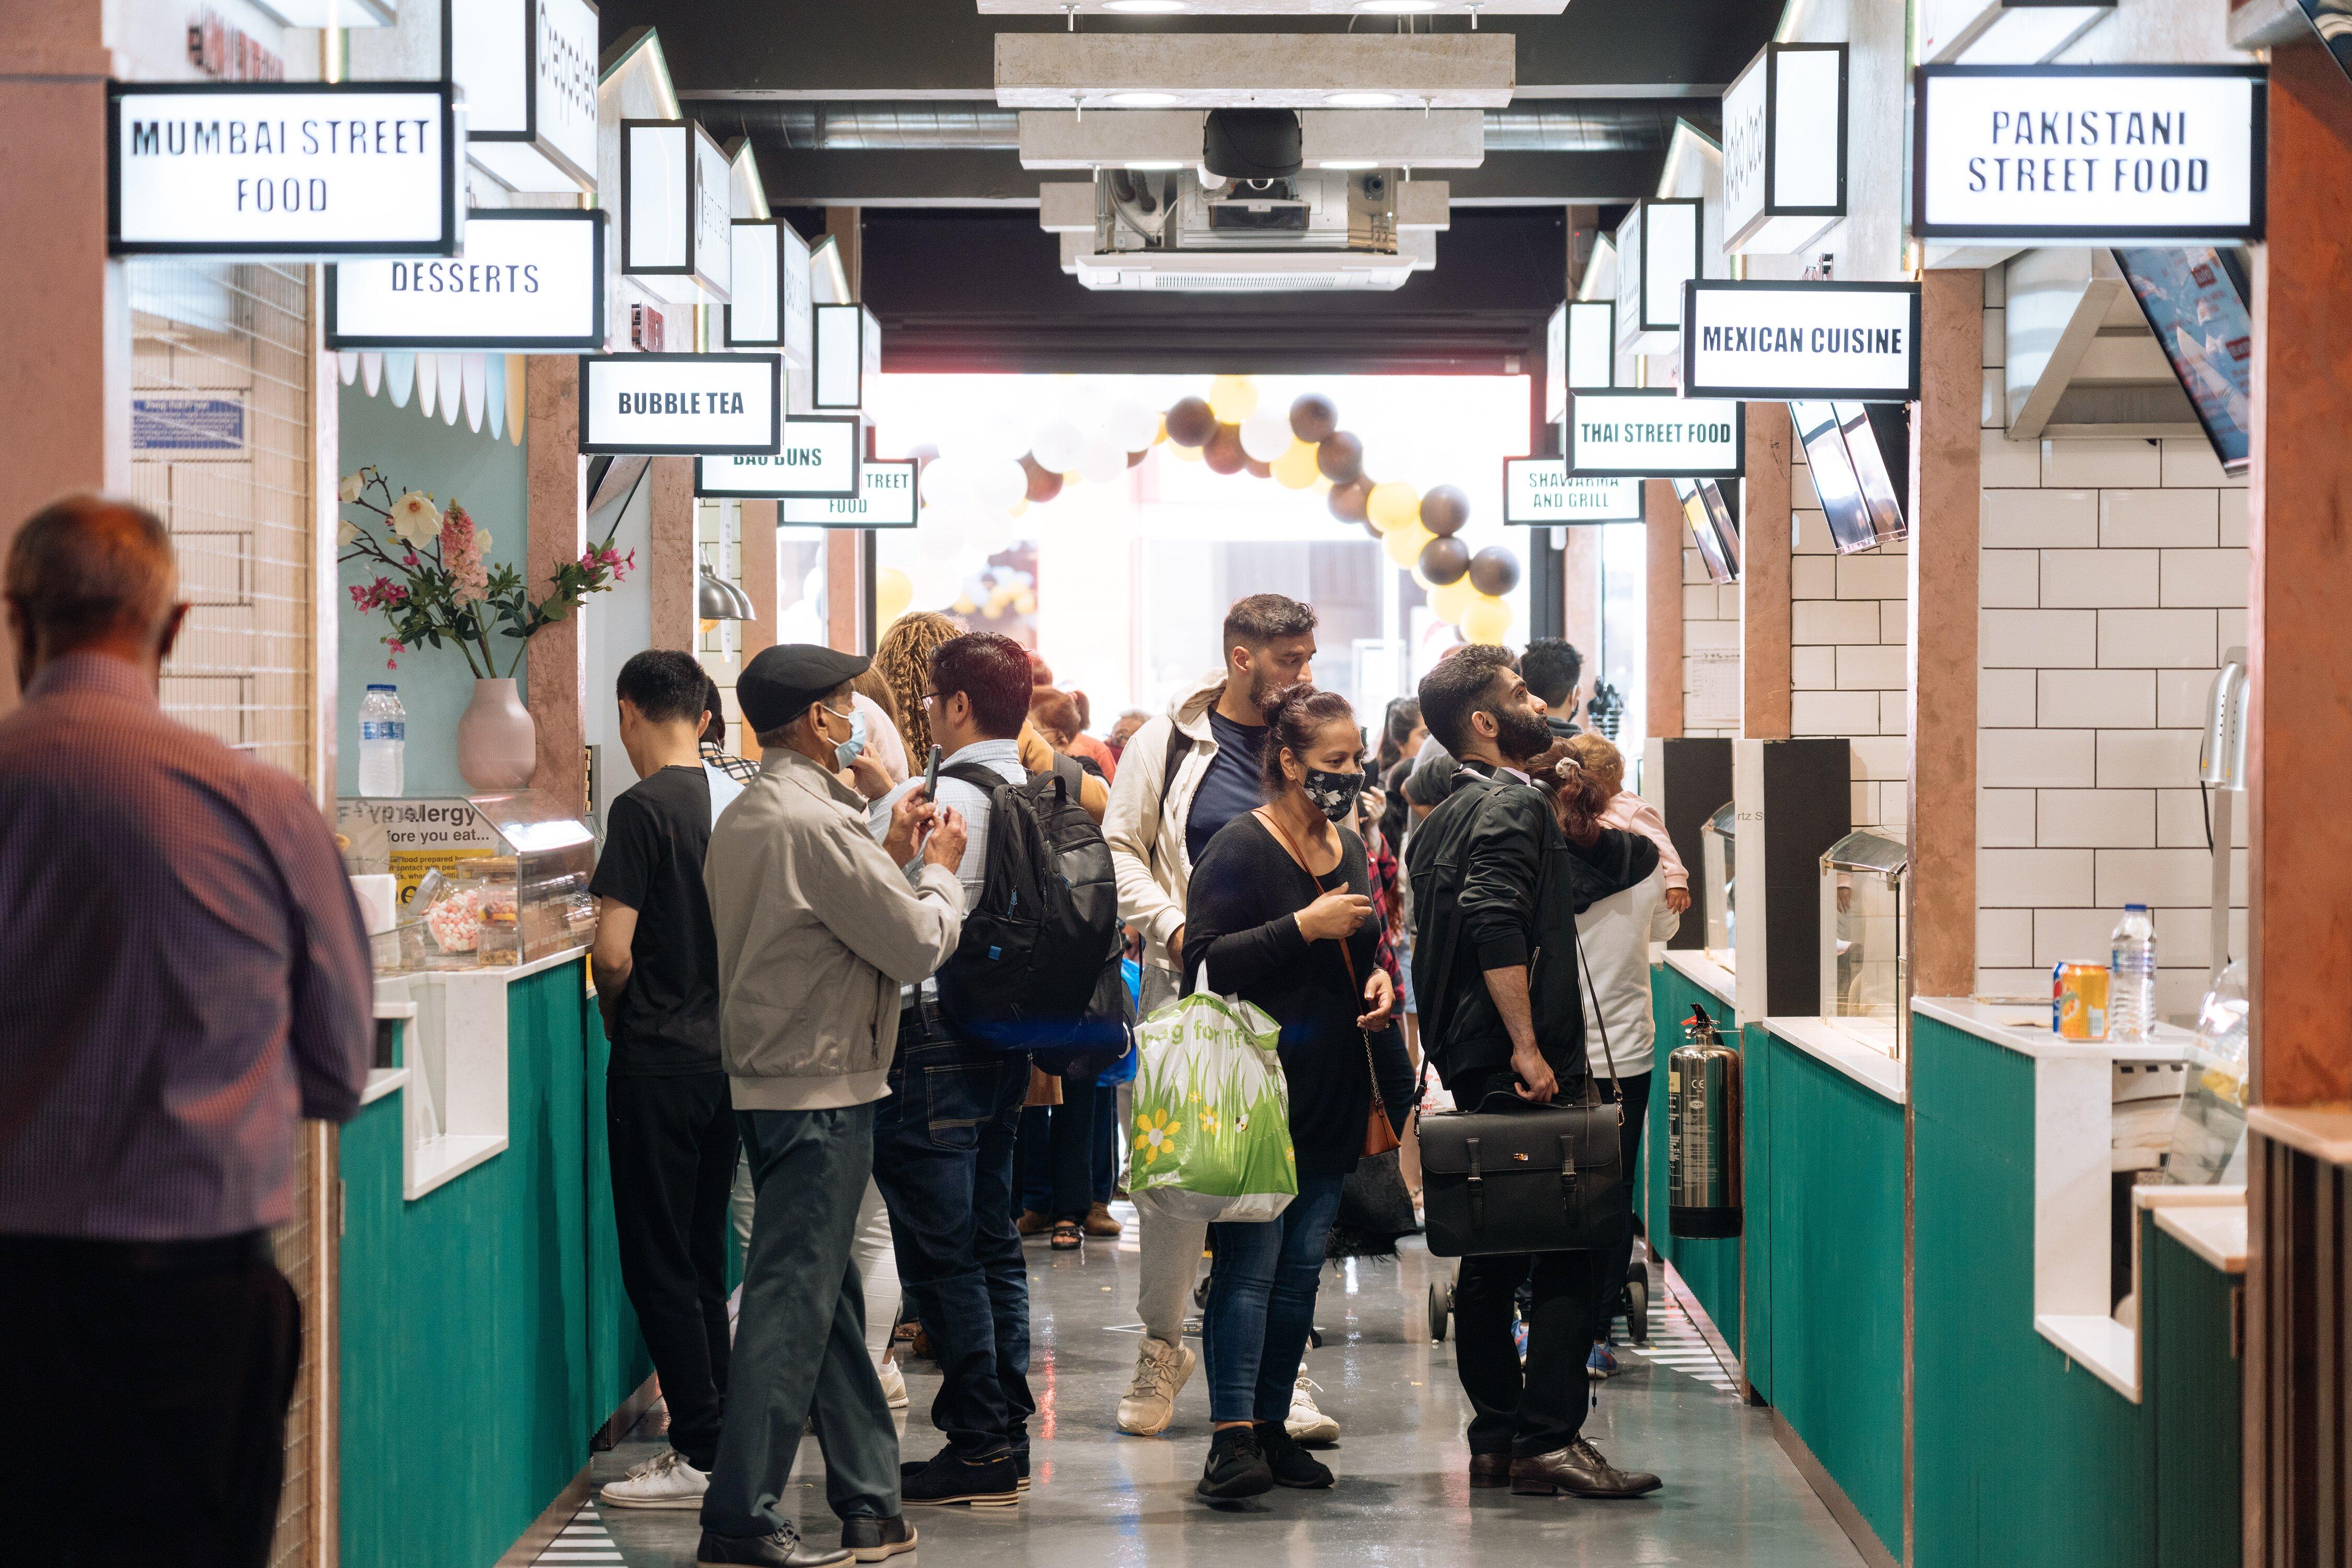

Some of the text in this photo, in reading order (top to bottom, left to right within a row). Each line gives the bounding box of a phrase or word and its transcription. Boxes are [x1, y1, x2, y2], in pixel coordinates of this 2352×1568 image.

[132, 119, 430, 156] MUMBAI STREET
[1992, 111, 2186, 146] PAKISTANI
[1725, 116, 1745, 211] koko
[1968, 157, 2209, 193] STREET FOOD
[238, 178, 327, 212] FOOD
[391, 261, 539, 293] DESSERTS
[1703, 326, 1902, 354] MEXICAN CUISINE
[618, 392, 745, 415] BUBBLE TEA
[1581, 423, 1731, 443] THAI STREET FOOD
[774, 448, 822, 466] BUNS
[866, 474, 909, 489] TREET
[829, 499, 868, 513] FOOD
[1533, 492, 1609, 508] AND GRILL
[1737, 811, 1764, 821] rtz S
[420, 832, 448, 845] you
[1193, 1019, 1219, 1045] for
